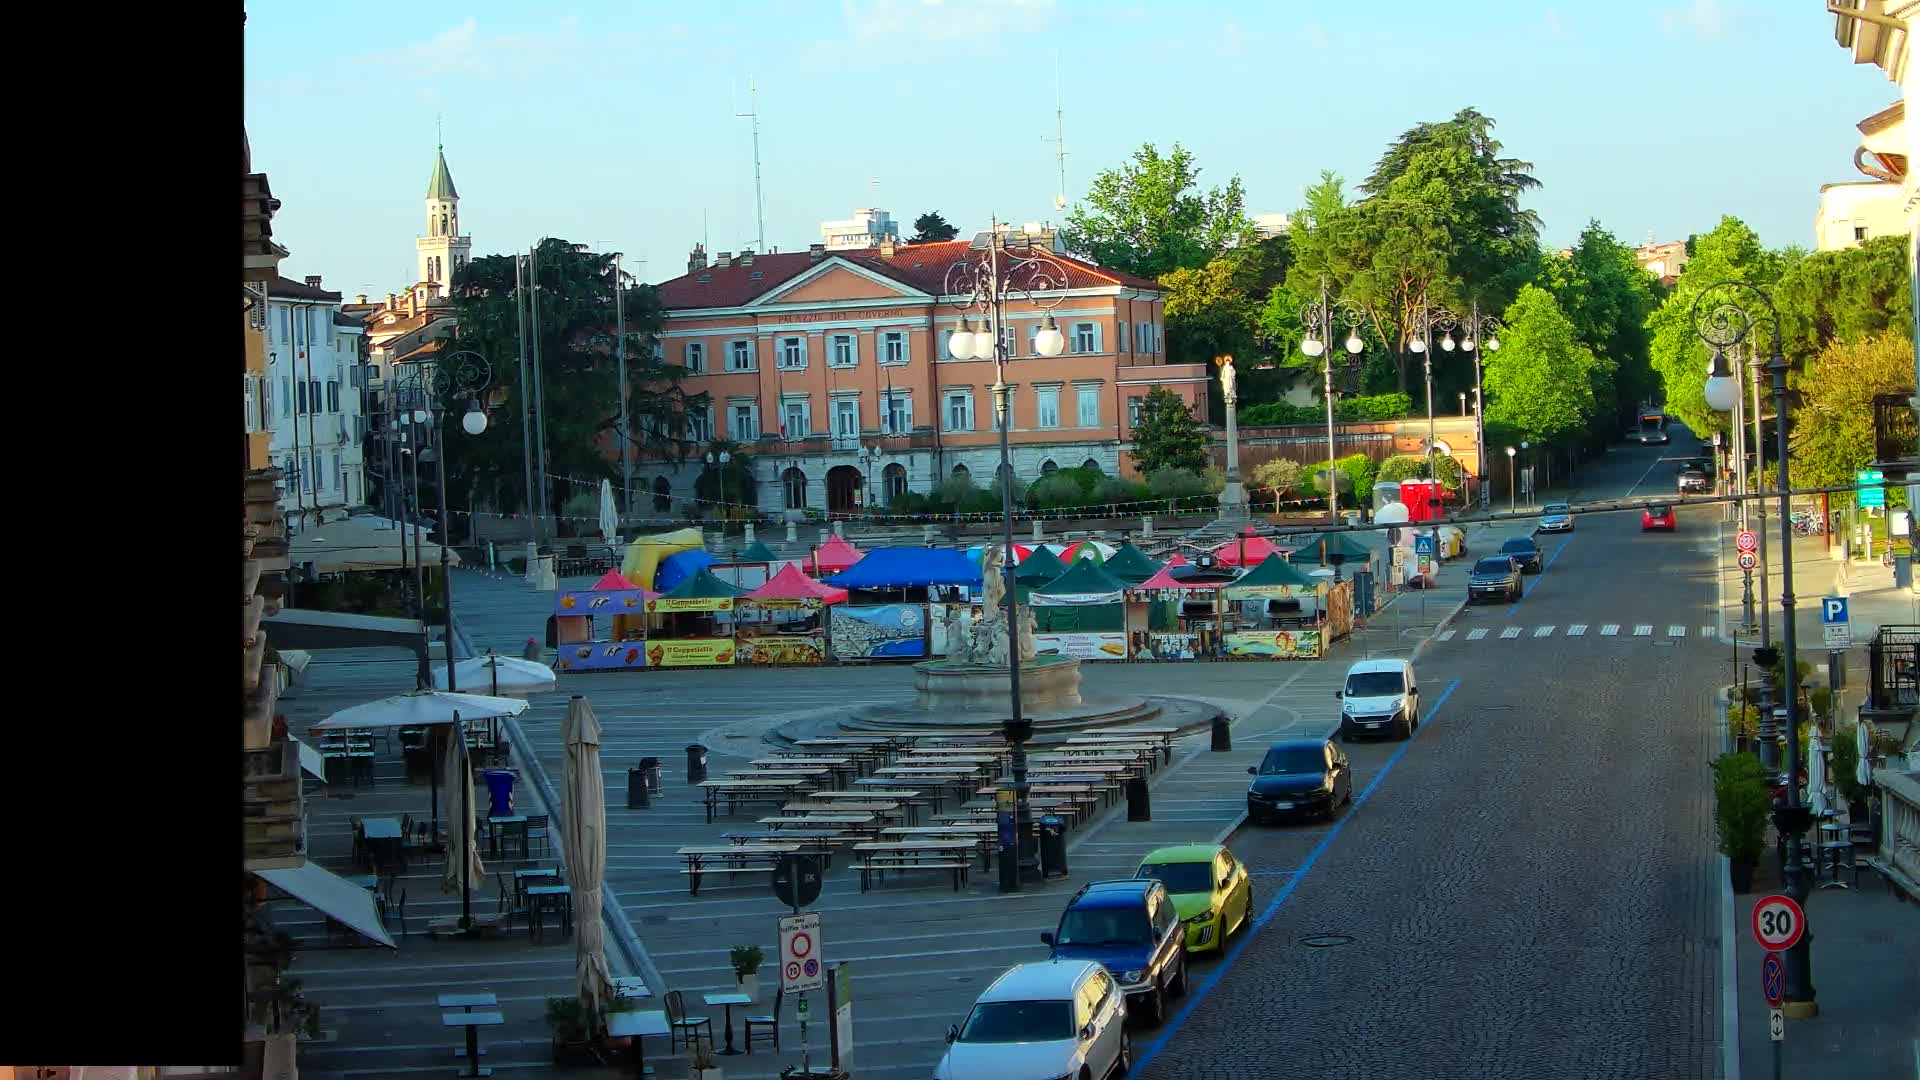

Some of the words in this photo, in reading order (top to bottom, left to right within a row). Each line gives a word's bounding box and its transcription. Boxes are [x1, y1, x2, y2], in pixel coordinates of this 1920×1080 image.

[1742, 556, 1752, 566] 20
[1828, 600, 1843, 622] P
[1762, 910, 1791, 937] 30
